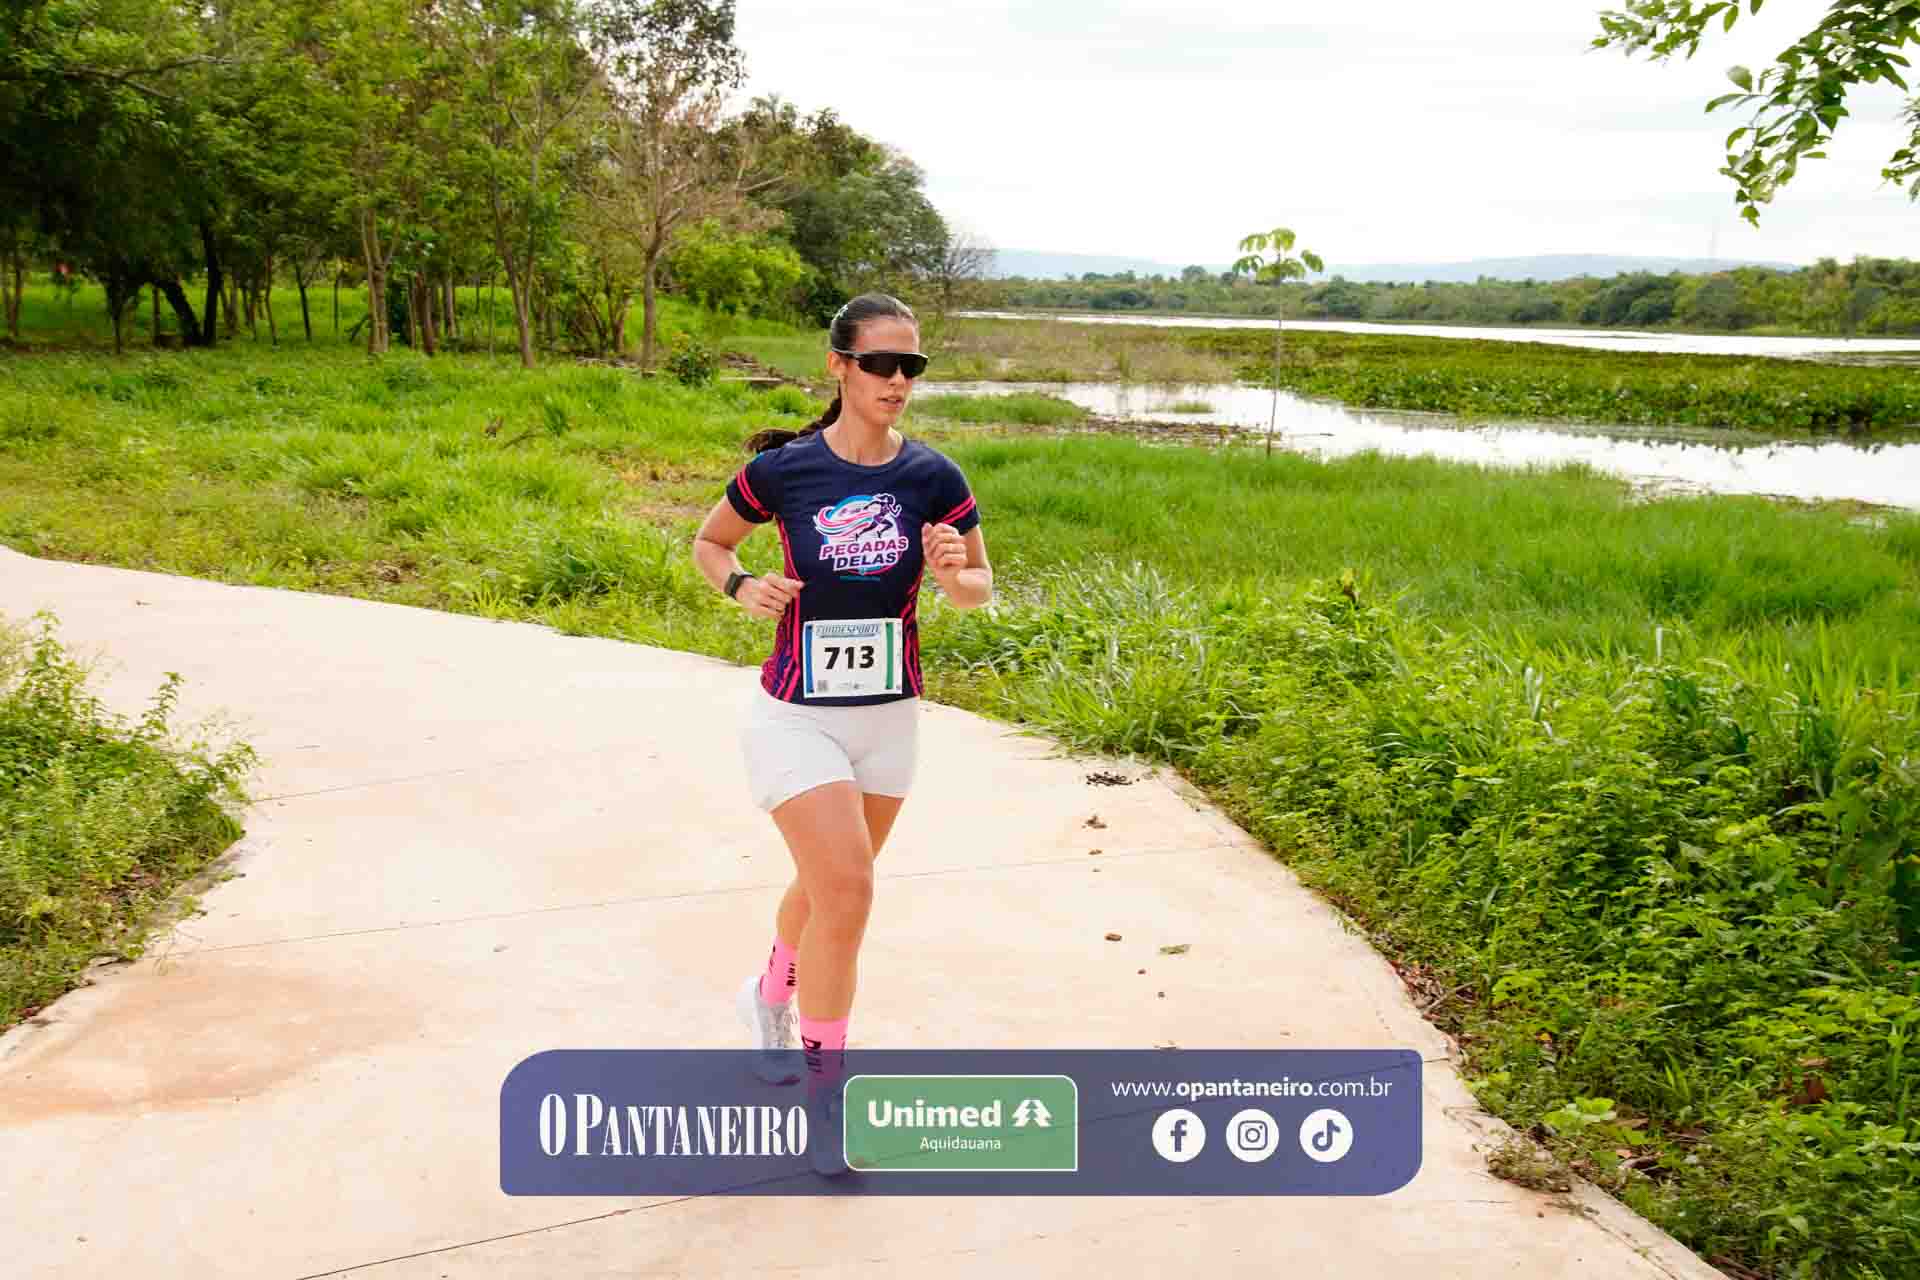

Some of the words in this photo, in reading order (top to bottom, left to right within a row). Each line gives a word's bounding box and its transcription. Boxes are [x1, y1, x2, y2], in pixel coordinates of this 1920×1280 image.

[821, 538, 908, 558] PEGADAS
[835, 552, 897, 569] DELAS
[823, 645, 875, 670] 713
